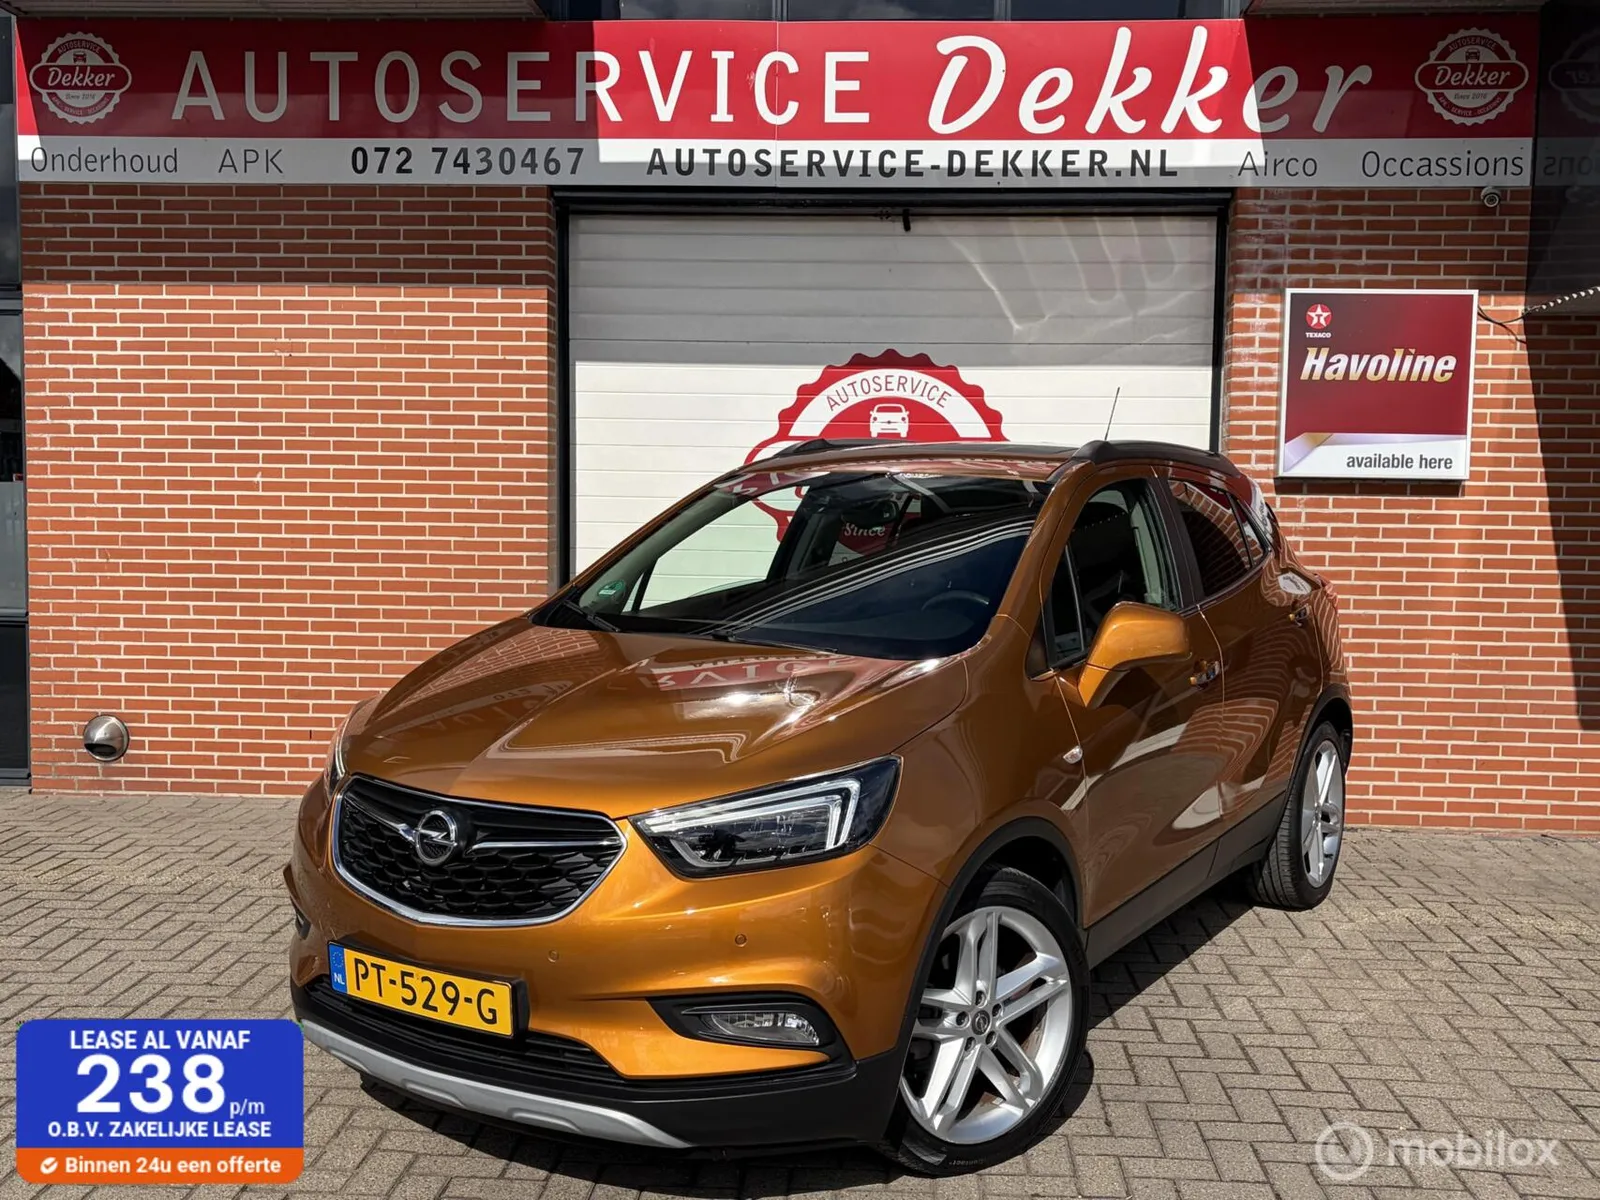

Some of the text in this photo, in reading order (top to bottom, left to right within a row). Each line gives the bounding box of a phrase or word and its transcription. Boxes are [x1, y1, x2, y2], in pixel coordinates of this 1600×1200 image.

[57, 40, 100, 54] AUTOSERVICE
[1448, 36, 1497, 52] AUTOSERVICE
[47, 66, 115, 86] Dekker
[172, 26, 1372, 135] AUTOSERVICE Dekker
[1434, 63, 1510, 86] Dekker
[30, 146, 178, 175] Onderhoud
[218, 149, 284, 174] APK
[351, 147, 585, 175] 072 7430467
[646, 147, 1179, 178] AUTOSERVICE-DEKKER.NL
[1237, 150, 1319, 178] Airco
[1361, 150, 1524, 178] Occassions
[1300, 347, 1457, 383] Havoline
[826, 375, 952, 412] AUTOSERVICE
[1346, 453, 1453, 469] available here
[844, 523, 886, 537] Since
[333, 972, 345, 985] NL
[354, 958, 498, 1025] PT-529-G
